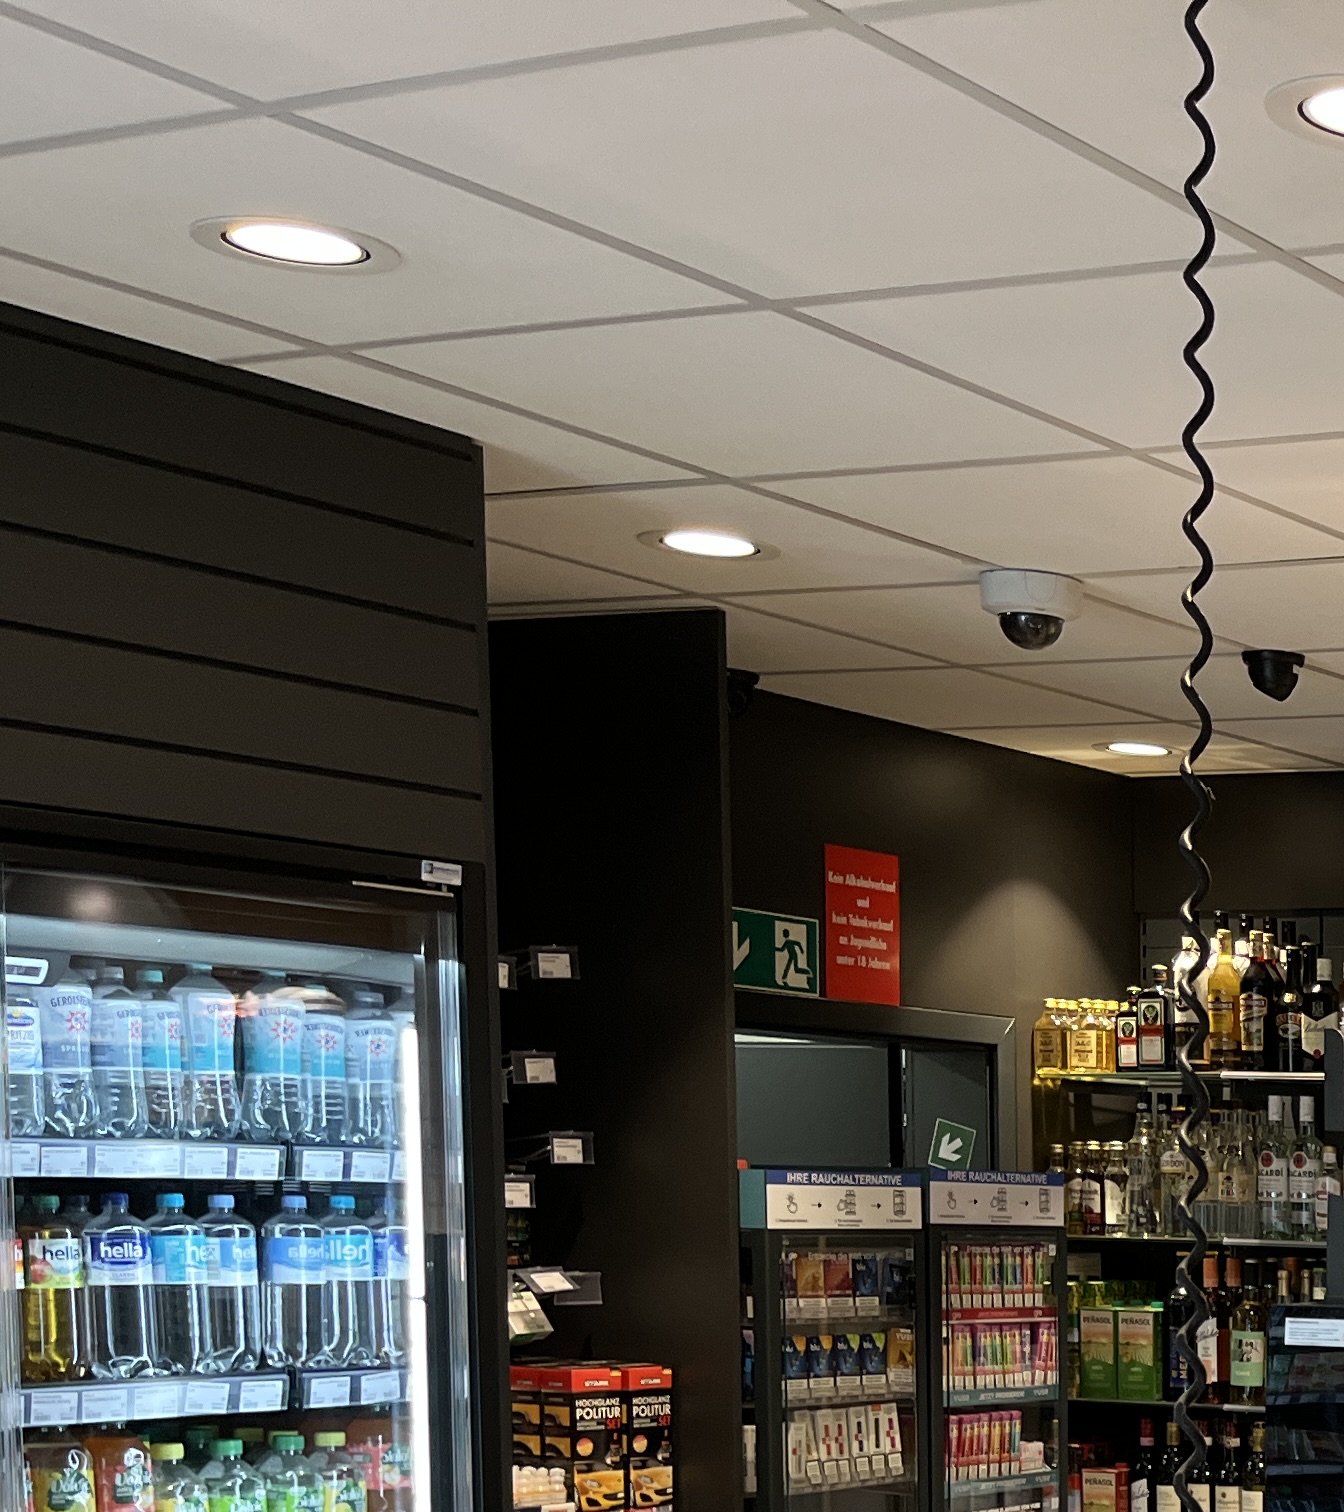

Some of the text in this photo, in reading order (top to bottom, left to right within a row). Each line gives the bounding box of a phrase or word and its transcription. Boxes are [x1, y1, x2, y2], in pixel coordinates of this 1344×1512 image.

[786, 1172, 902, 1186] IHRE RAUCHALTERNATIVE
[947, 1171, 1048, 1186] IHRE RAUCHALTERNATIVE
[99, 1244, 144, 1261] hella
[576, 1406, 620, 1420] POLITUR
[632, 1404, 671, 1417] POLITUR
